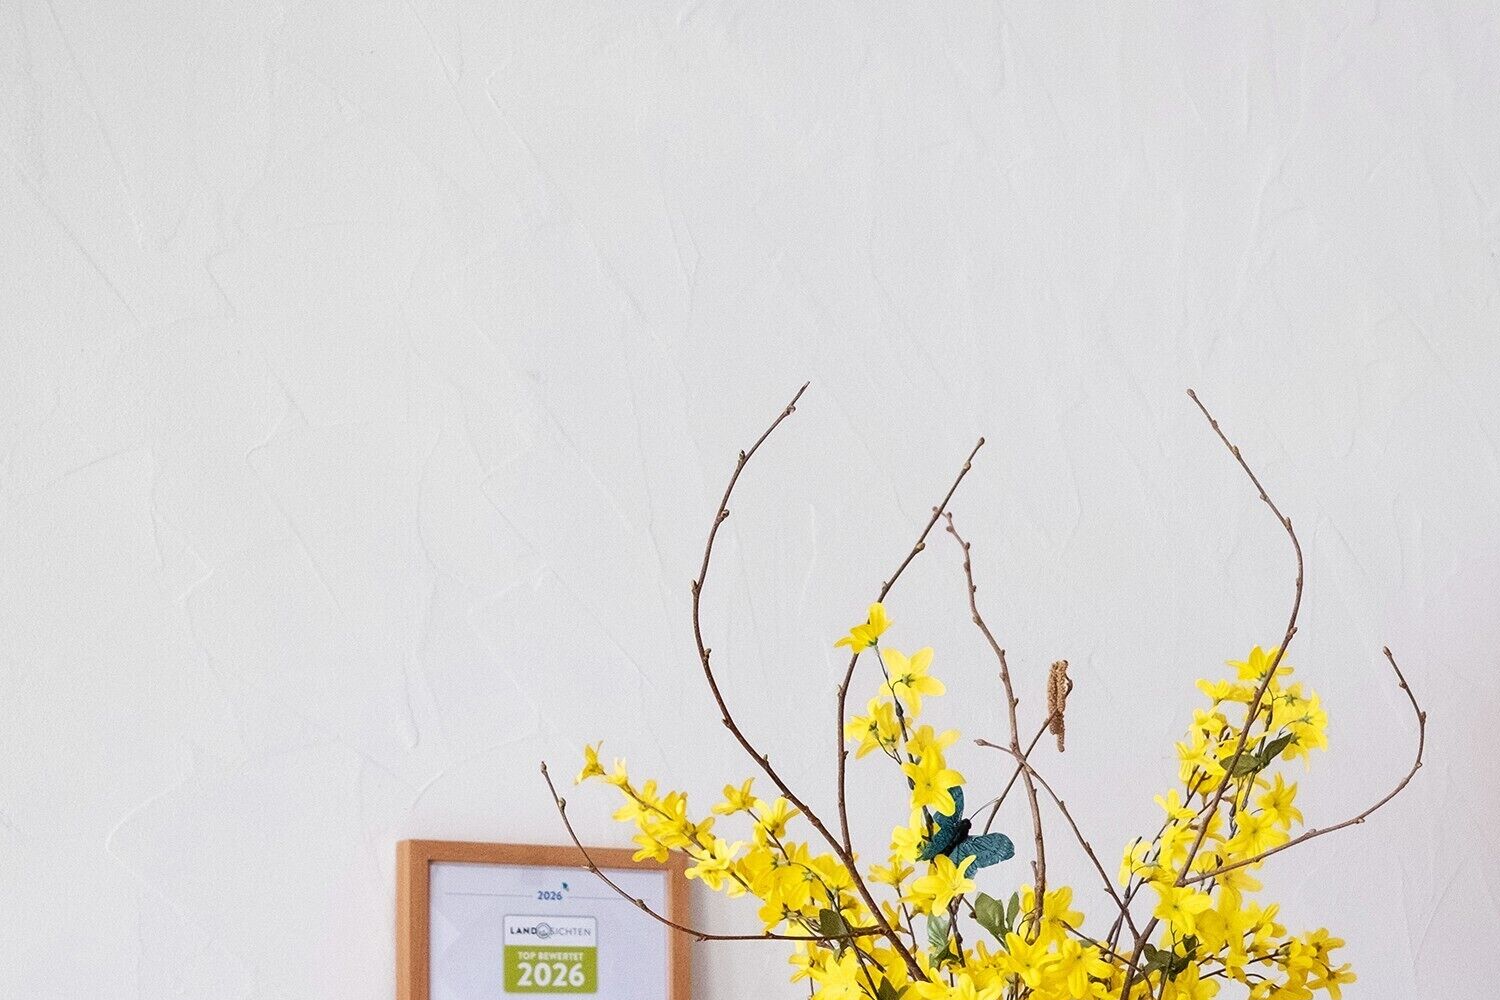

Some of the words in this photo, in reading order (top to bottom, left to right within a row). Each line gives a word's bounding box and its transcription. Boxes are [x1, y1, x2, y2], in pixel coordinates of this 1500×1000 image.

[537, 890, 563, 900] 2026
[517, 952, 536, 961] TOP
[538, 952, 584, 962] BEWERTET
[516, 961, 586, 988] 2026
